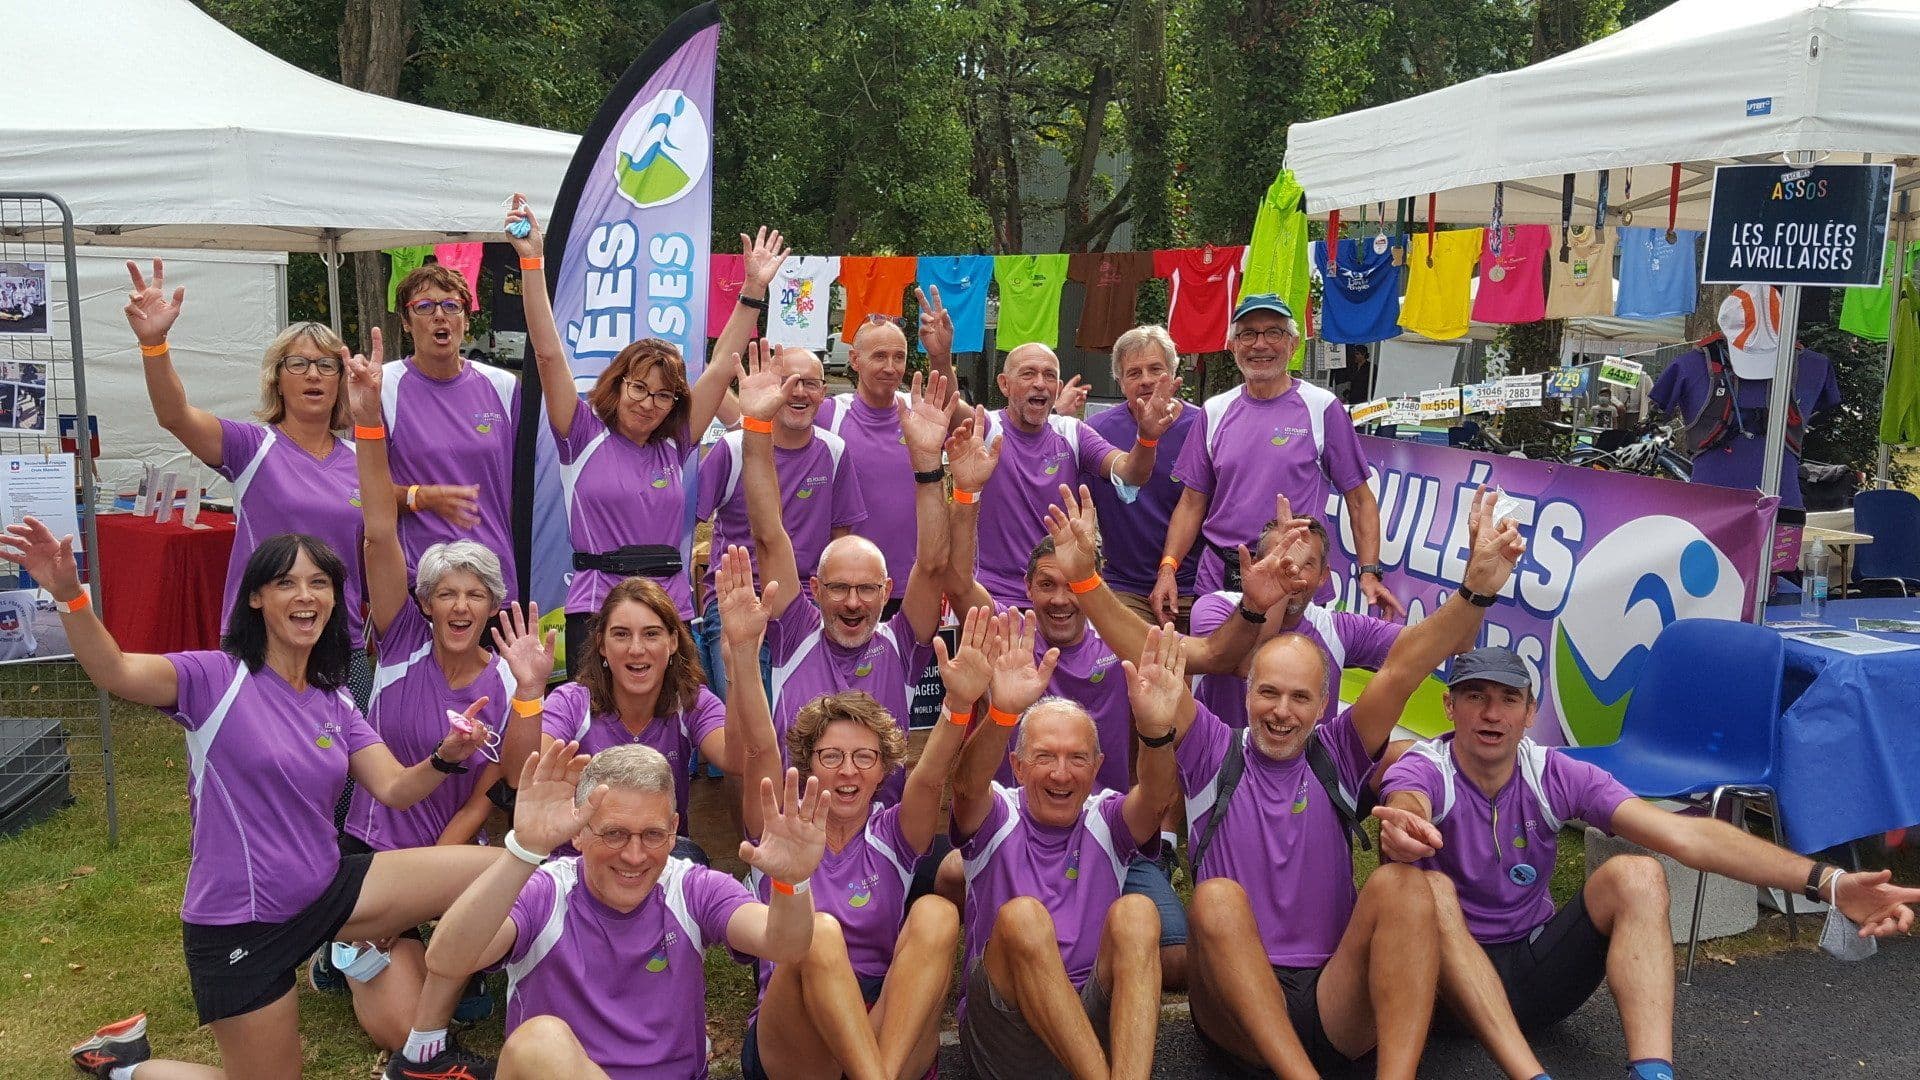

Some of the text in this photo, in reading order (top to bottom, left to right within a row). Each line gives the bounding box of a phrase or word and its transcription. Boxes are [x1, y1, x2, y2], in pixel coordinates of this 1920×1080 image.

[1772, 179, 1828, 200] ASSOS
[1732, 219, 1857, 248] LES FOULÉES
[1730, 246, 1854, 271] AVRILLAISES
[647, 234, 690, 357] SES
[1554, 372, 1580, 388] 229
[1477, 387, 1503, 397] 31046
[1508, 388, 1530, 399] 2883
[1395, 402, 1420, 411] 31480
